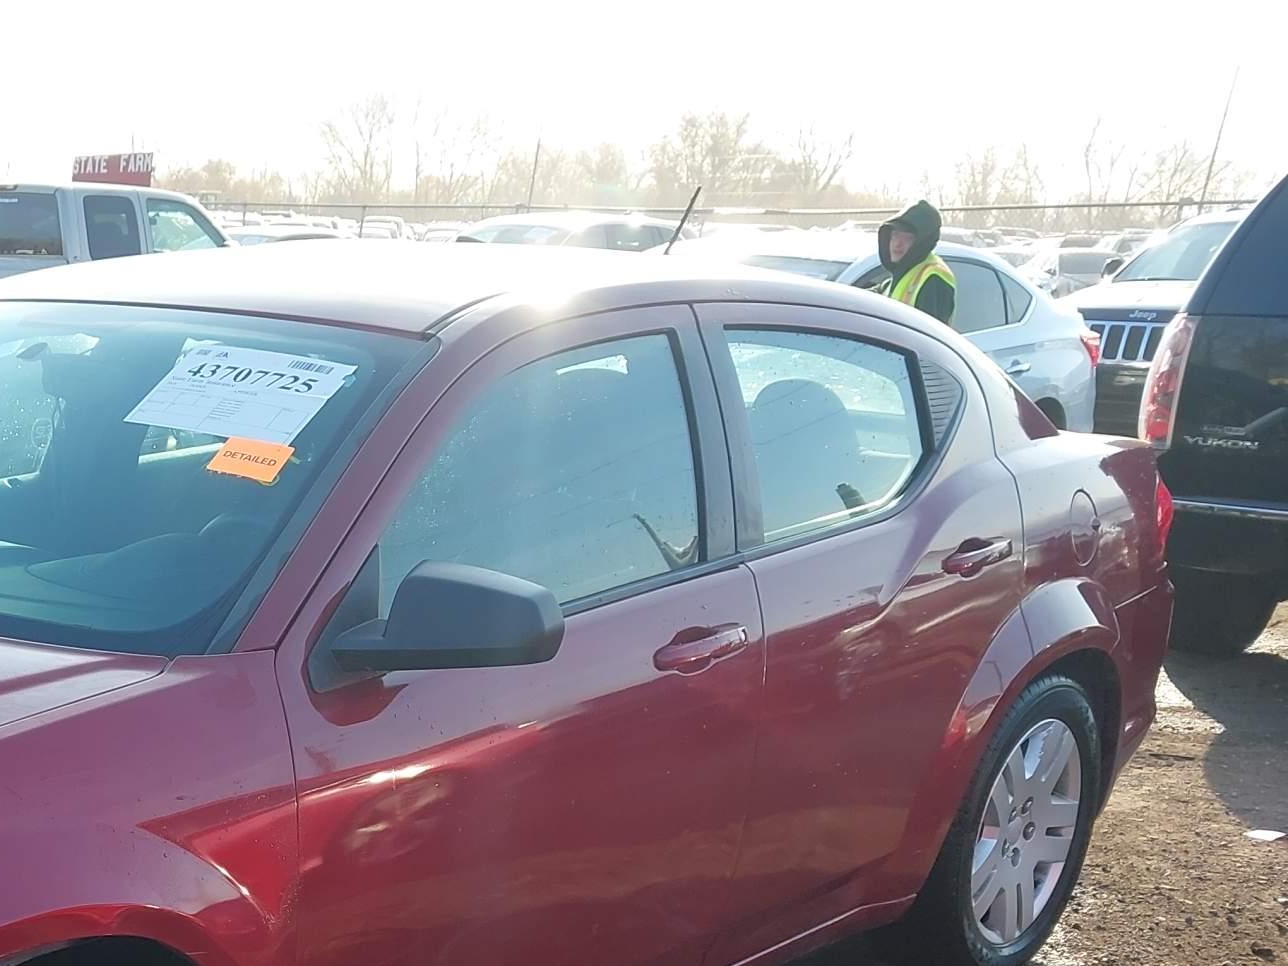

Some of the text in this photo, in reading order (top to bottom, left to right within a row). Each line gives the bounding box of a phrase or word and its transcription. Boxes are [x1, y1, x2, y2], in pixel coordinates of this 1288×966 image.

[72, 153, 153, 175] STATE FARM
[1128, 309, 1157, 321] Jeep
[186, 362, 320, 393] 43707725
[1183, 435, 1259, 450] YUKON
[222, 450, 277, 468] DETAILED
